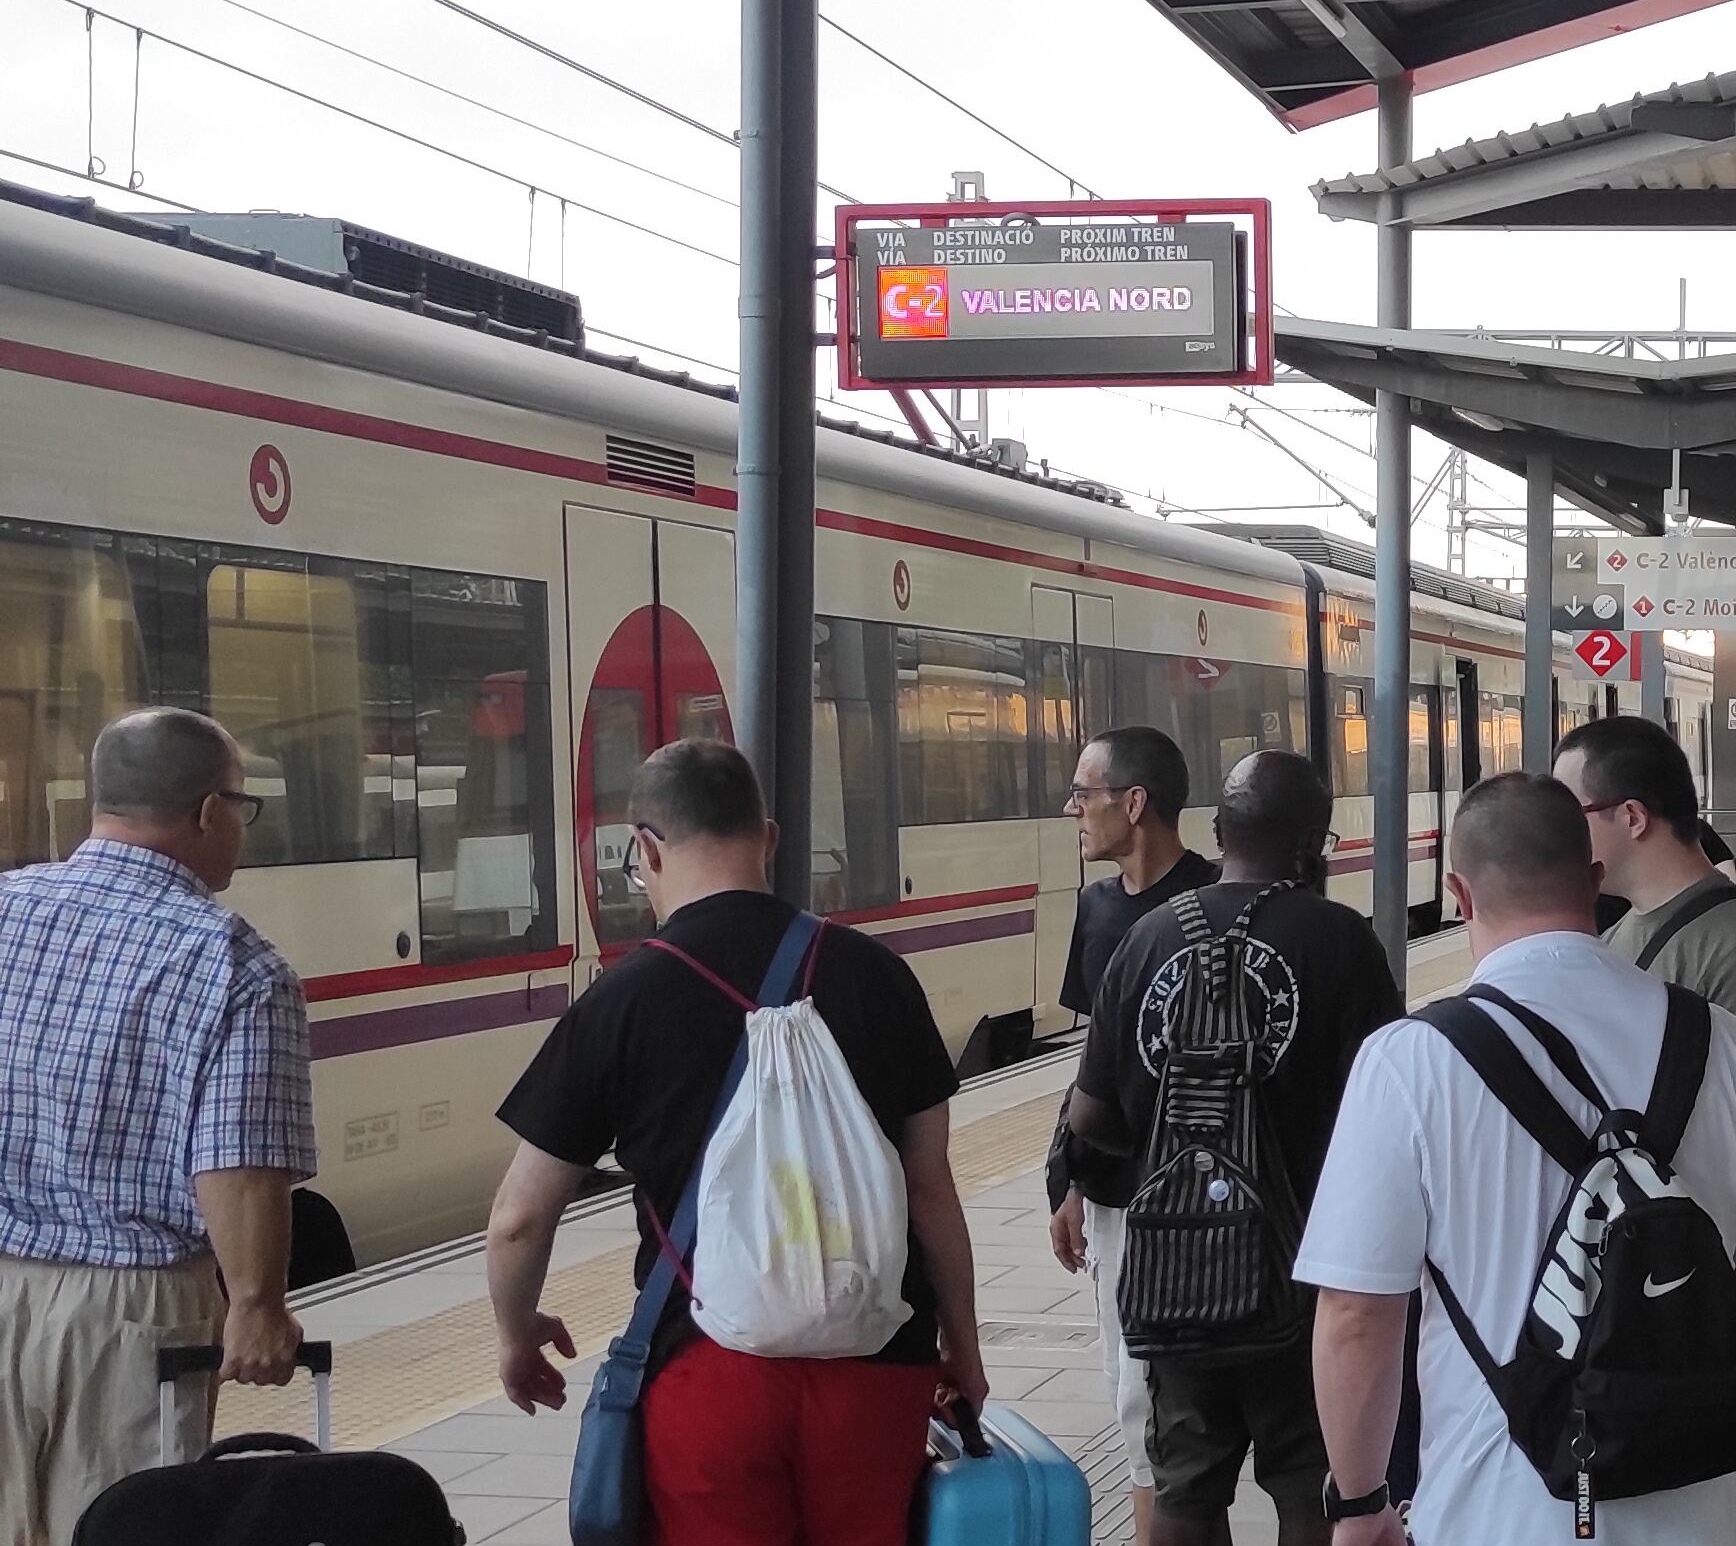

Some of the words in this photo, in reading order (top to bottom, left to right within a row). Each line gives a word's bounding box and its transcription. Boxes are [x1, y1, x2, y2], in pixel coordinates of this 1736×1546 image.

[876, 232, 906, 247] VIA
[933, 226, 1034, 246] DESTINACIÓ
[1131, 226, 1175, 243] TREN
[877, 246, 907, 265] VÍA
[933, 248, 1007, 265] DESTINO
[1060, 244, 1140, 262] PRÓXIMO
[1143, 245, 1188, 261] TREN
[885, 285, 945, 319] C-2
[961, 289, 1102, 314] VALENCIA
[1108, 287, 1192, 311] NORD
[1612, 554, 1622, 568] 2
[1636, 553, 1669, 569] C-2
[1662, 599, 1695, 616] C-2
[1592, 636, 1611, 666] 2
